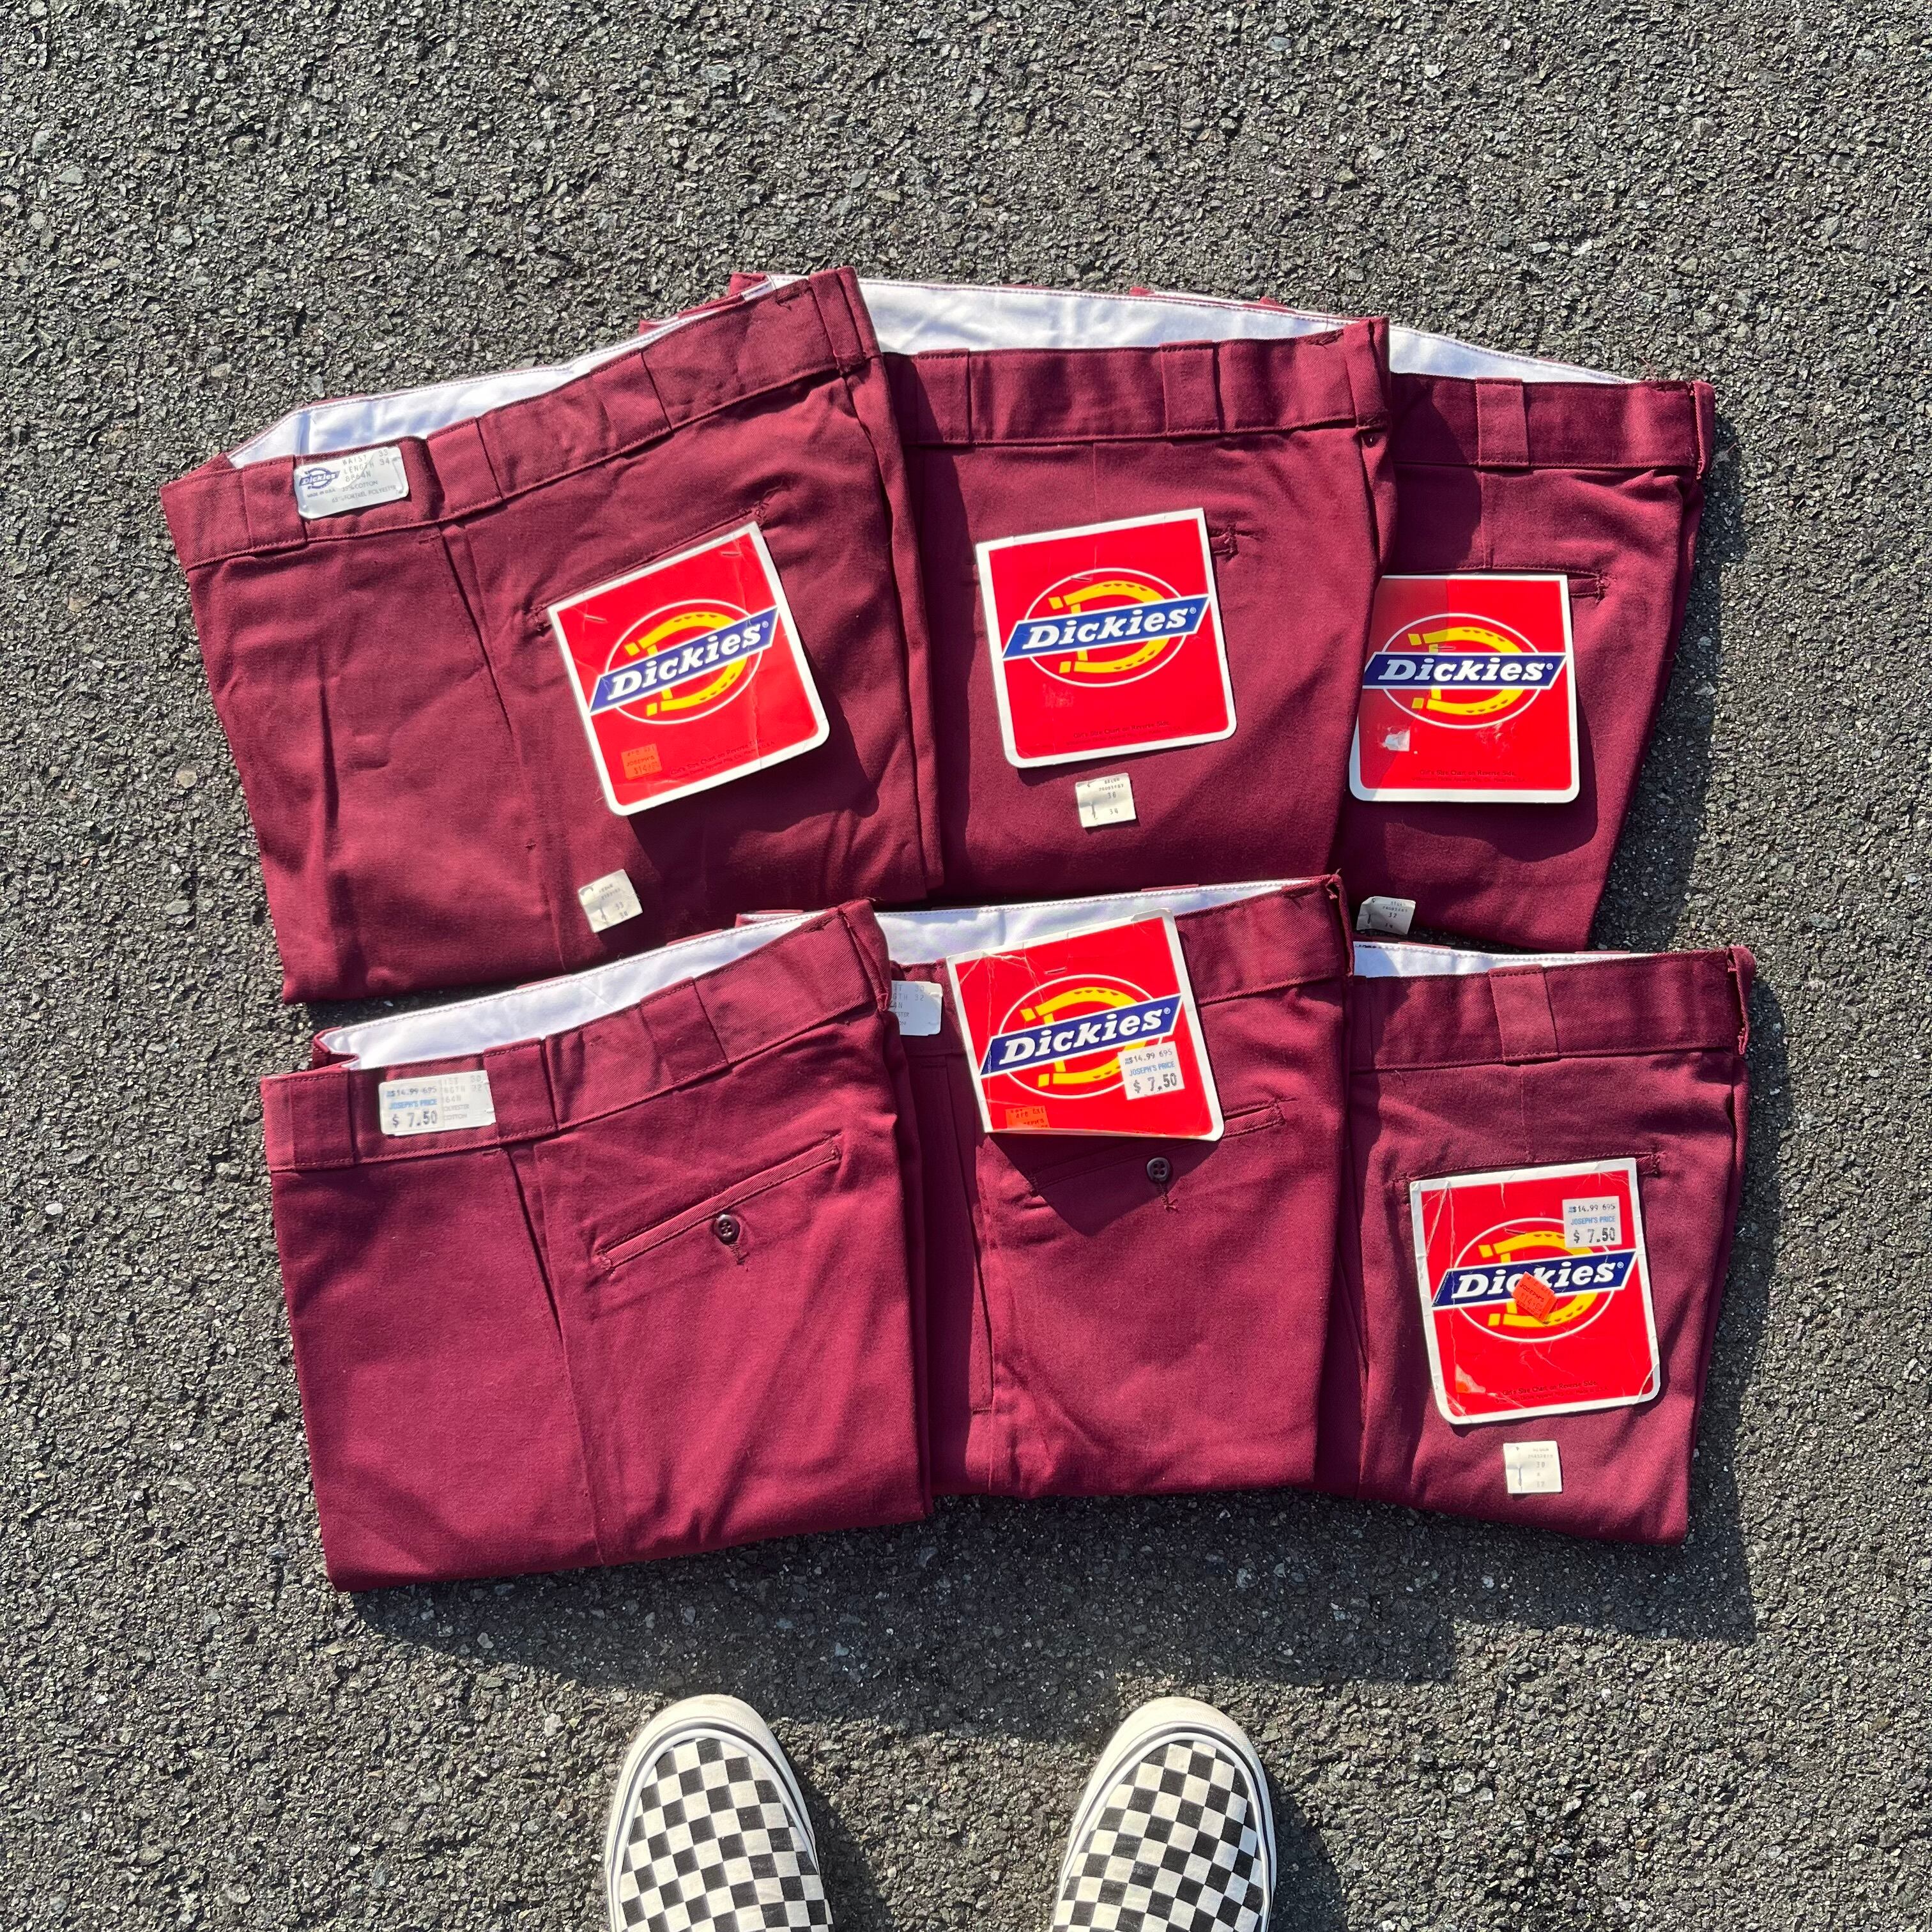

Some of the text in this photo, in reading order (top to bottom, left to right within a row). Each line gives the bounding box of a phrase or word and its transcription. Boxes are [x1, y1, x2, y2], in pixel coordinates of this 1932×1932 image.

[342, 448, 388, 465] WAIST 33
[344, 462, 374, 474] LENGTH
[302, 473, 335, 486] Dickies
[1159, 1048, 1172, 1057] 695
[1130, 1061, 1175, 1077] JOSEPH'S PRICE
[1570, 1217, 1598, 1225] JOSEPH'S
